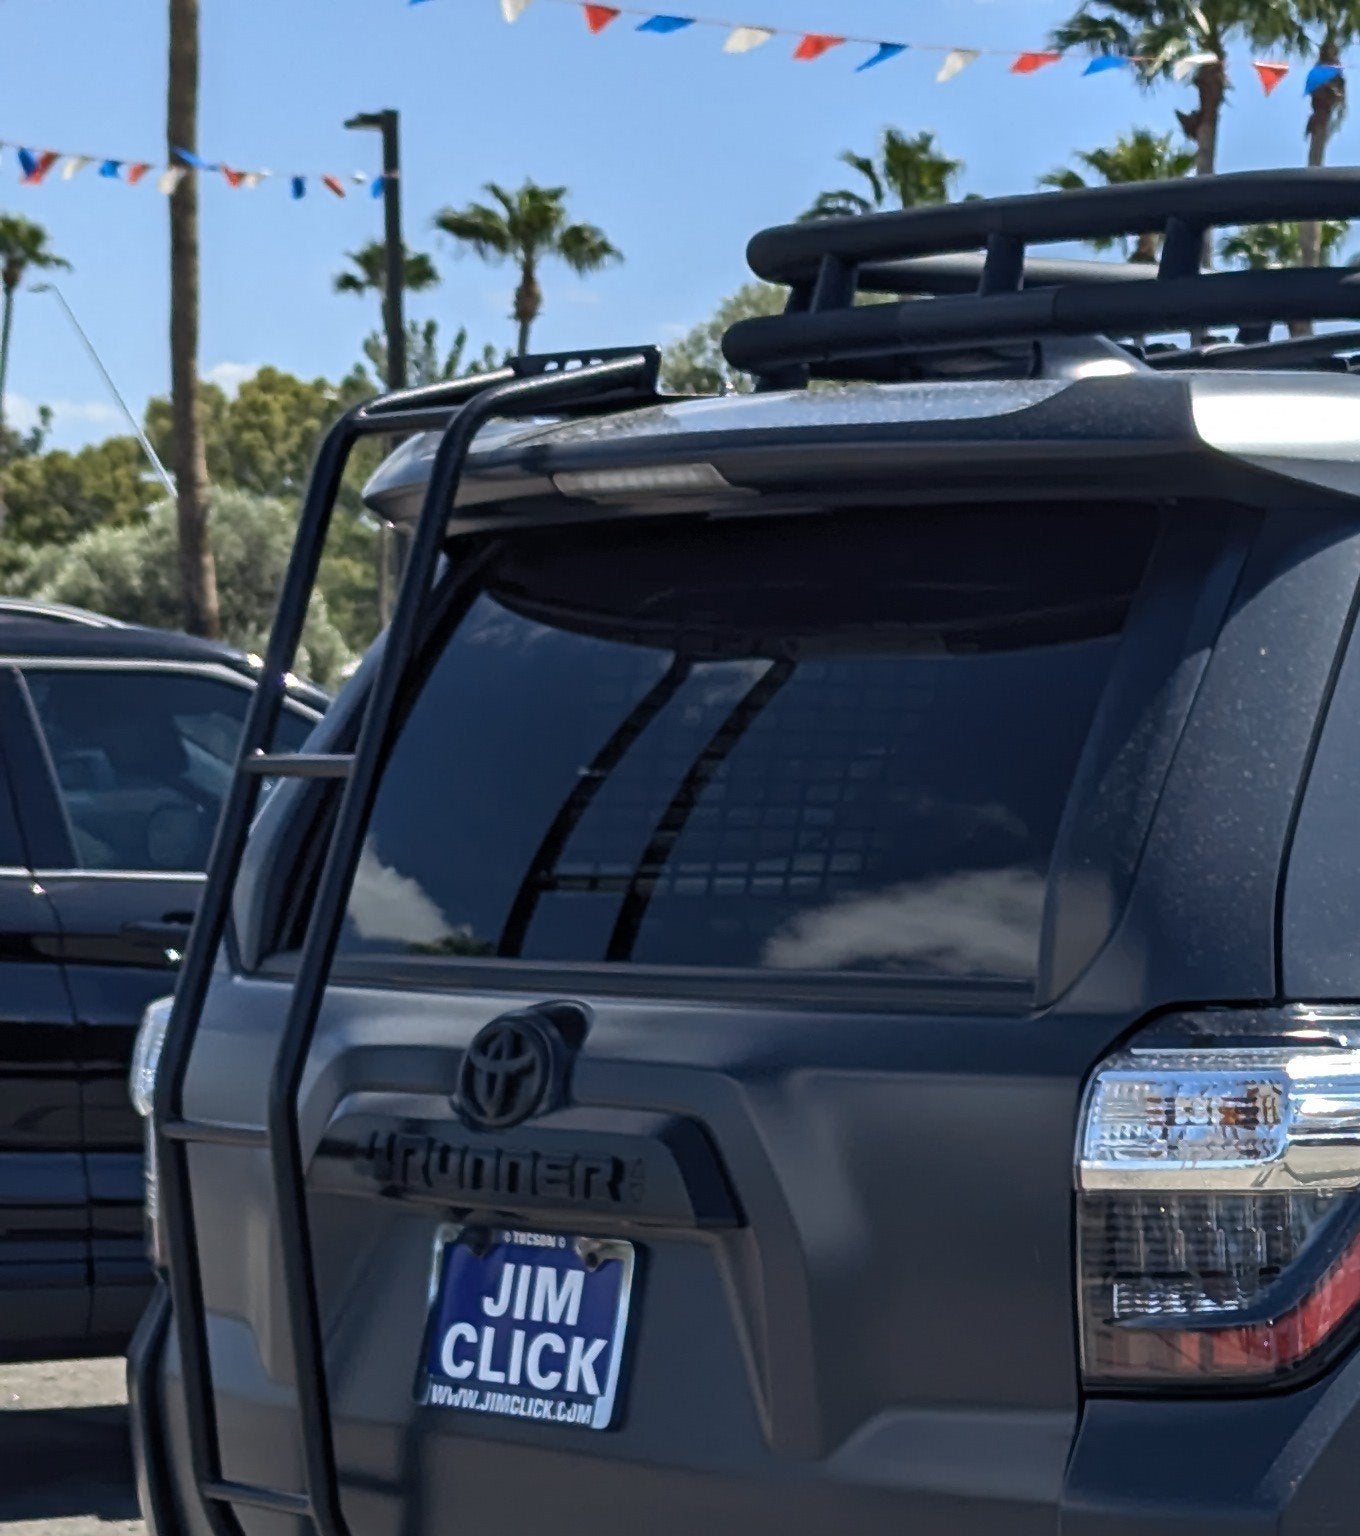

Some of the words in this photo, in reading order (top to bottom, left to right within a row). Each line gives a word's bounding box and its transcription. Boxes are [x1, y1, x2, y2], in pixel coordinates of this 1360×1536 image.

[482, 1262, 586, 1327] JIM
[440, 1321, 608, 1396] CLICK
[430, 1383, 594, 1425] WWW.JIMCLICK.COM
